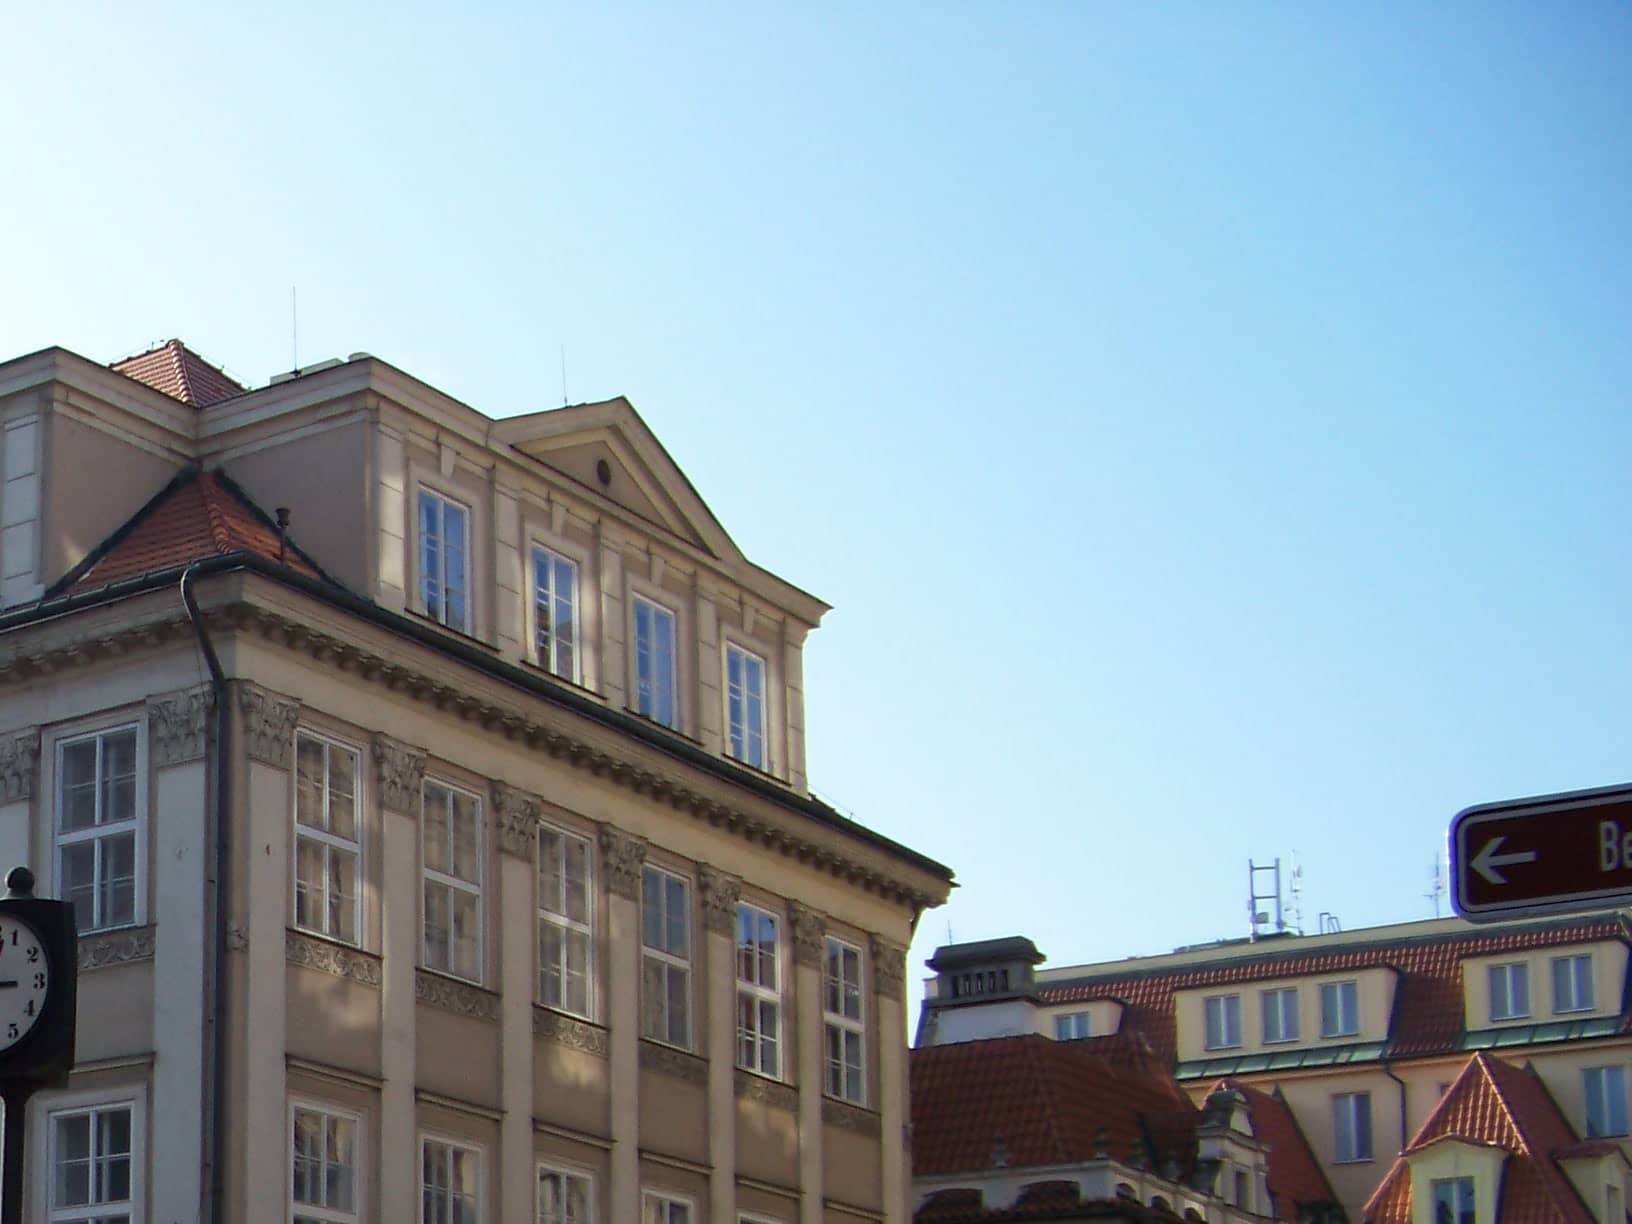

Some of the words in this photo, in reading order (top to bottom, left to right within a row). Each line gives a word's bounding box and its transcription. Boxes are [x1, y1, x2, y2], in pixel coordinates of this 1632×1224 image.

[10, 929, 19, 946] 1
[26, 947, 39, 964] 2
[33, 973, 46, 990] 3
[24, 999, 35, 1017] 4
[7, 1023, 20, 1039] 5
